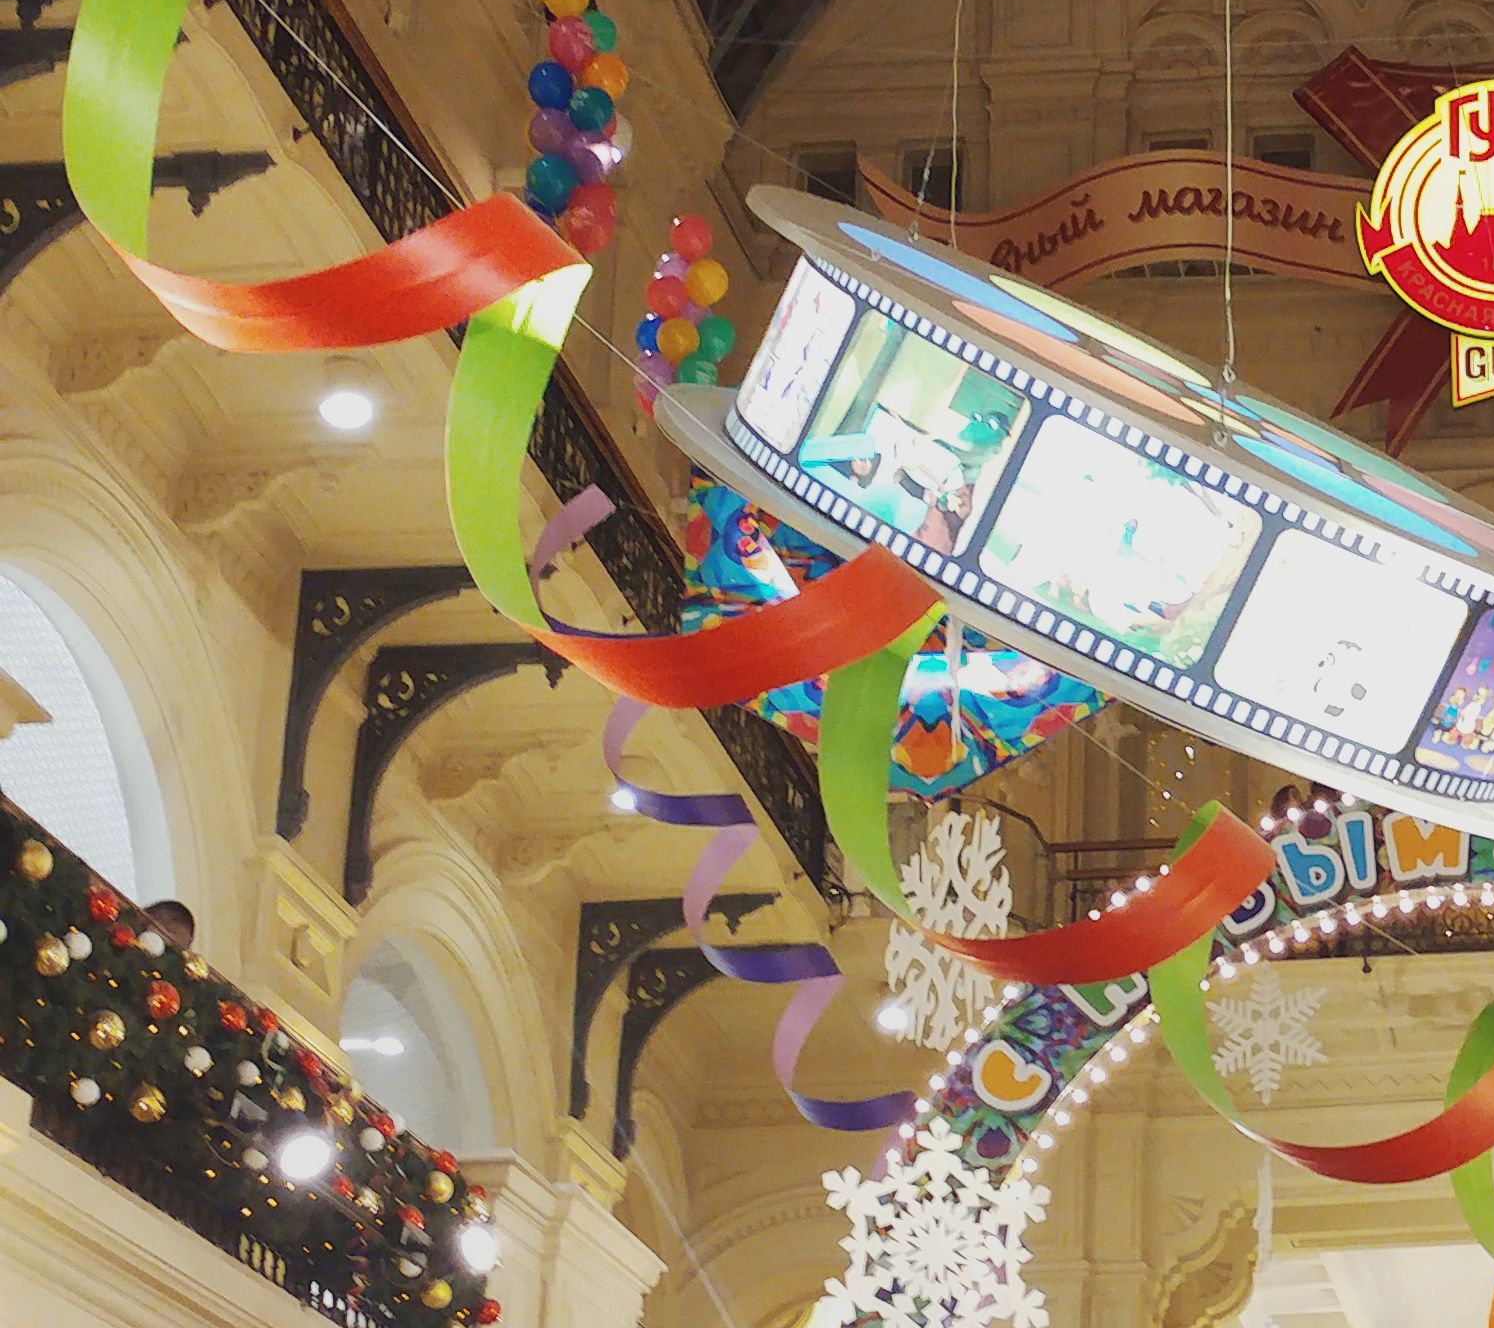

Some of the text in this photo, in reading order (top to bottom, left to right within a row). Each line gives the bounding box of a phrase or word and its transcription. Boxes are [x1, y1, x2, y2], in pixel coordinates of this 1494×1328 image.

[991, 192, 1105, 273] вный
[1127, 184, 1346, 245] магазин
[973, 1039, 1052, 1111] С
